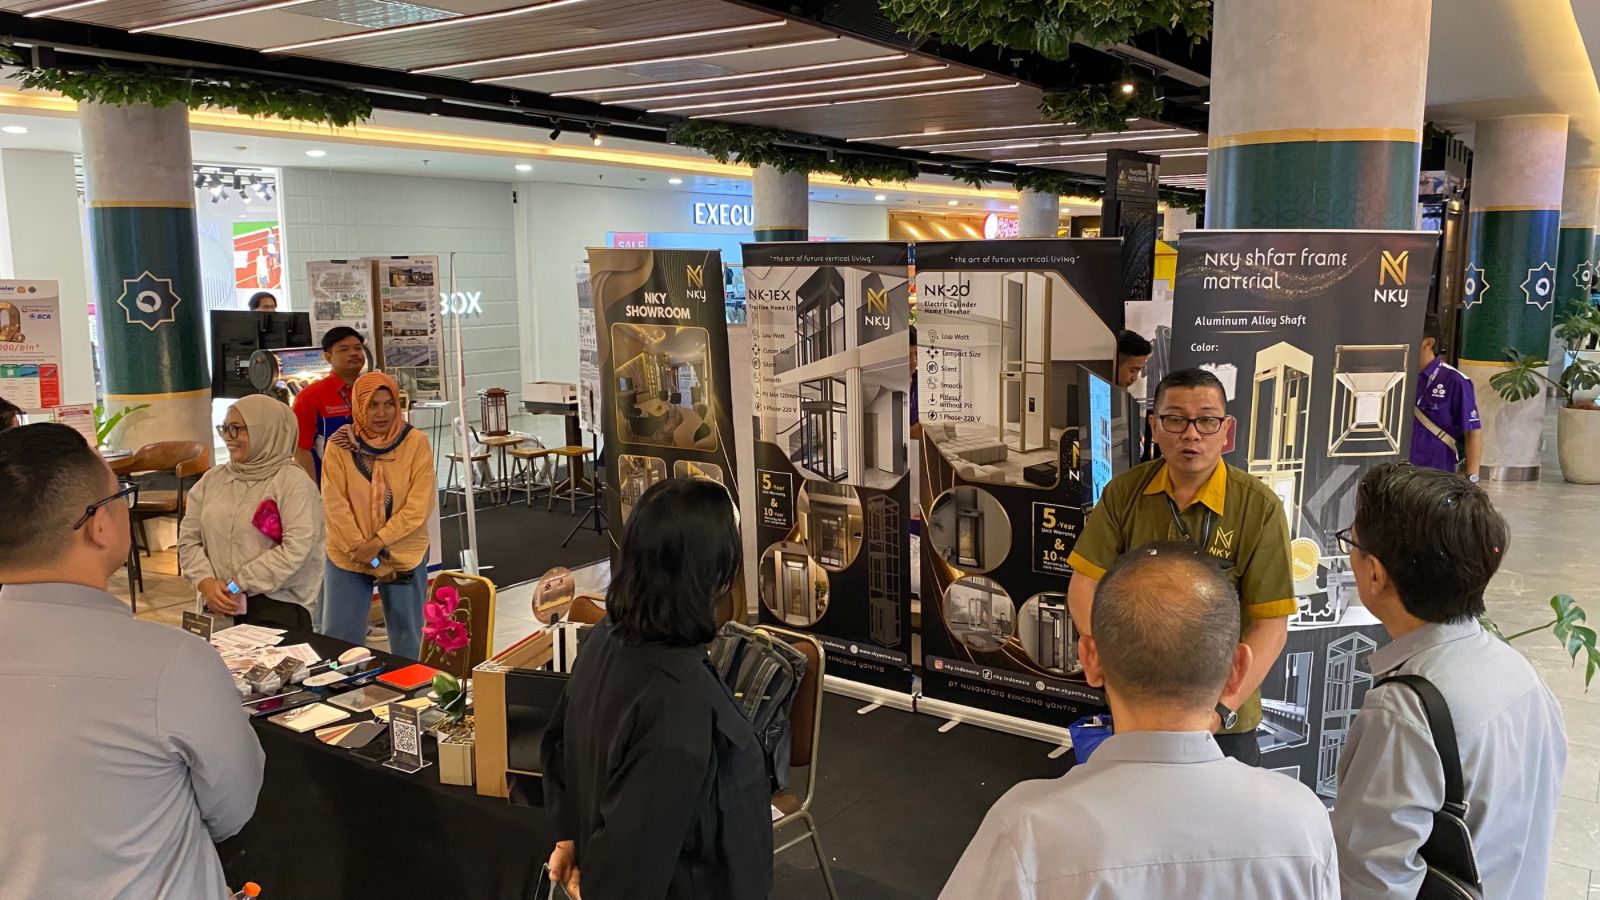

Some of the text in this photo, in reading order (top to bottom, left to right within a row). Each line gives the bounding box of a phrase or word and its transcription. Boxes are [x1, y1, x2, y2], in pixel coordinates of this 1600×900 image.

[694, 202, 754, 225] EXECU
[1204, 271, 1281, 290] material
[644, 292, 667, 304] NKY
[950, 301, 976, 309] Cylinder
[626, 306, 690, 319] SHOWROOM
[1194, 315, 1306, 327] Aluminum Alloy Shaft
[1191, 343, 1219, 352] Color:
[762, 473, 771, 490] 5
[771, 498, 778, 508] &
[764, 507, 773, 517] 10
[1042, 507, 1056, 529] 5
[1054, 529, 1076, 538] Warranty
[1054, 538, 1065, 551] &
[1043, 550, 1057, 561] 10
[1209, 546, 1231, 559] NKY
